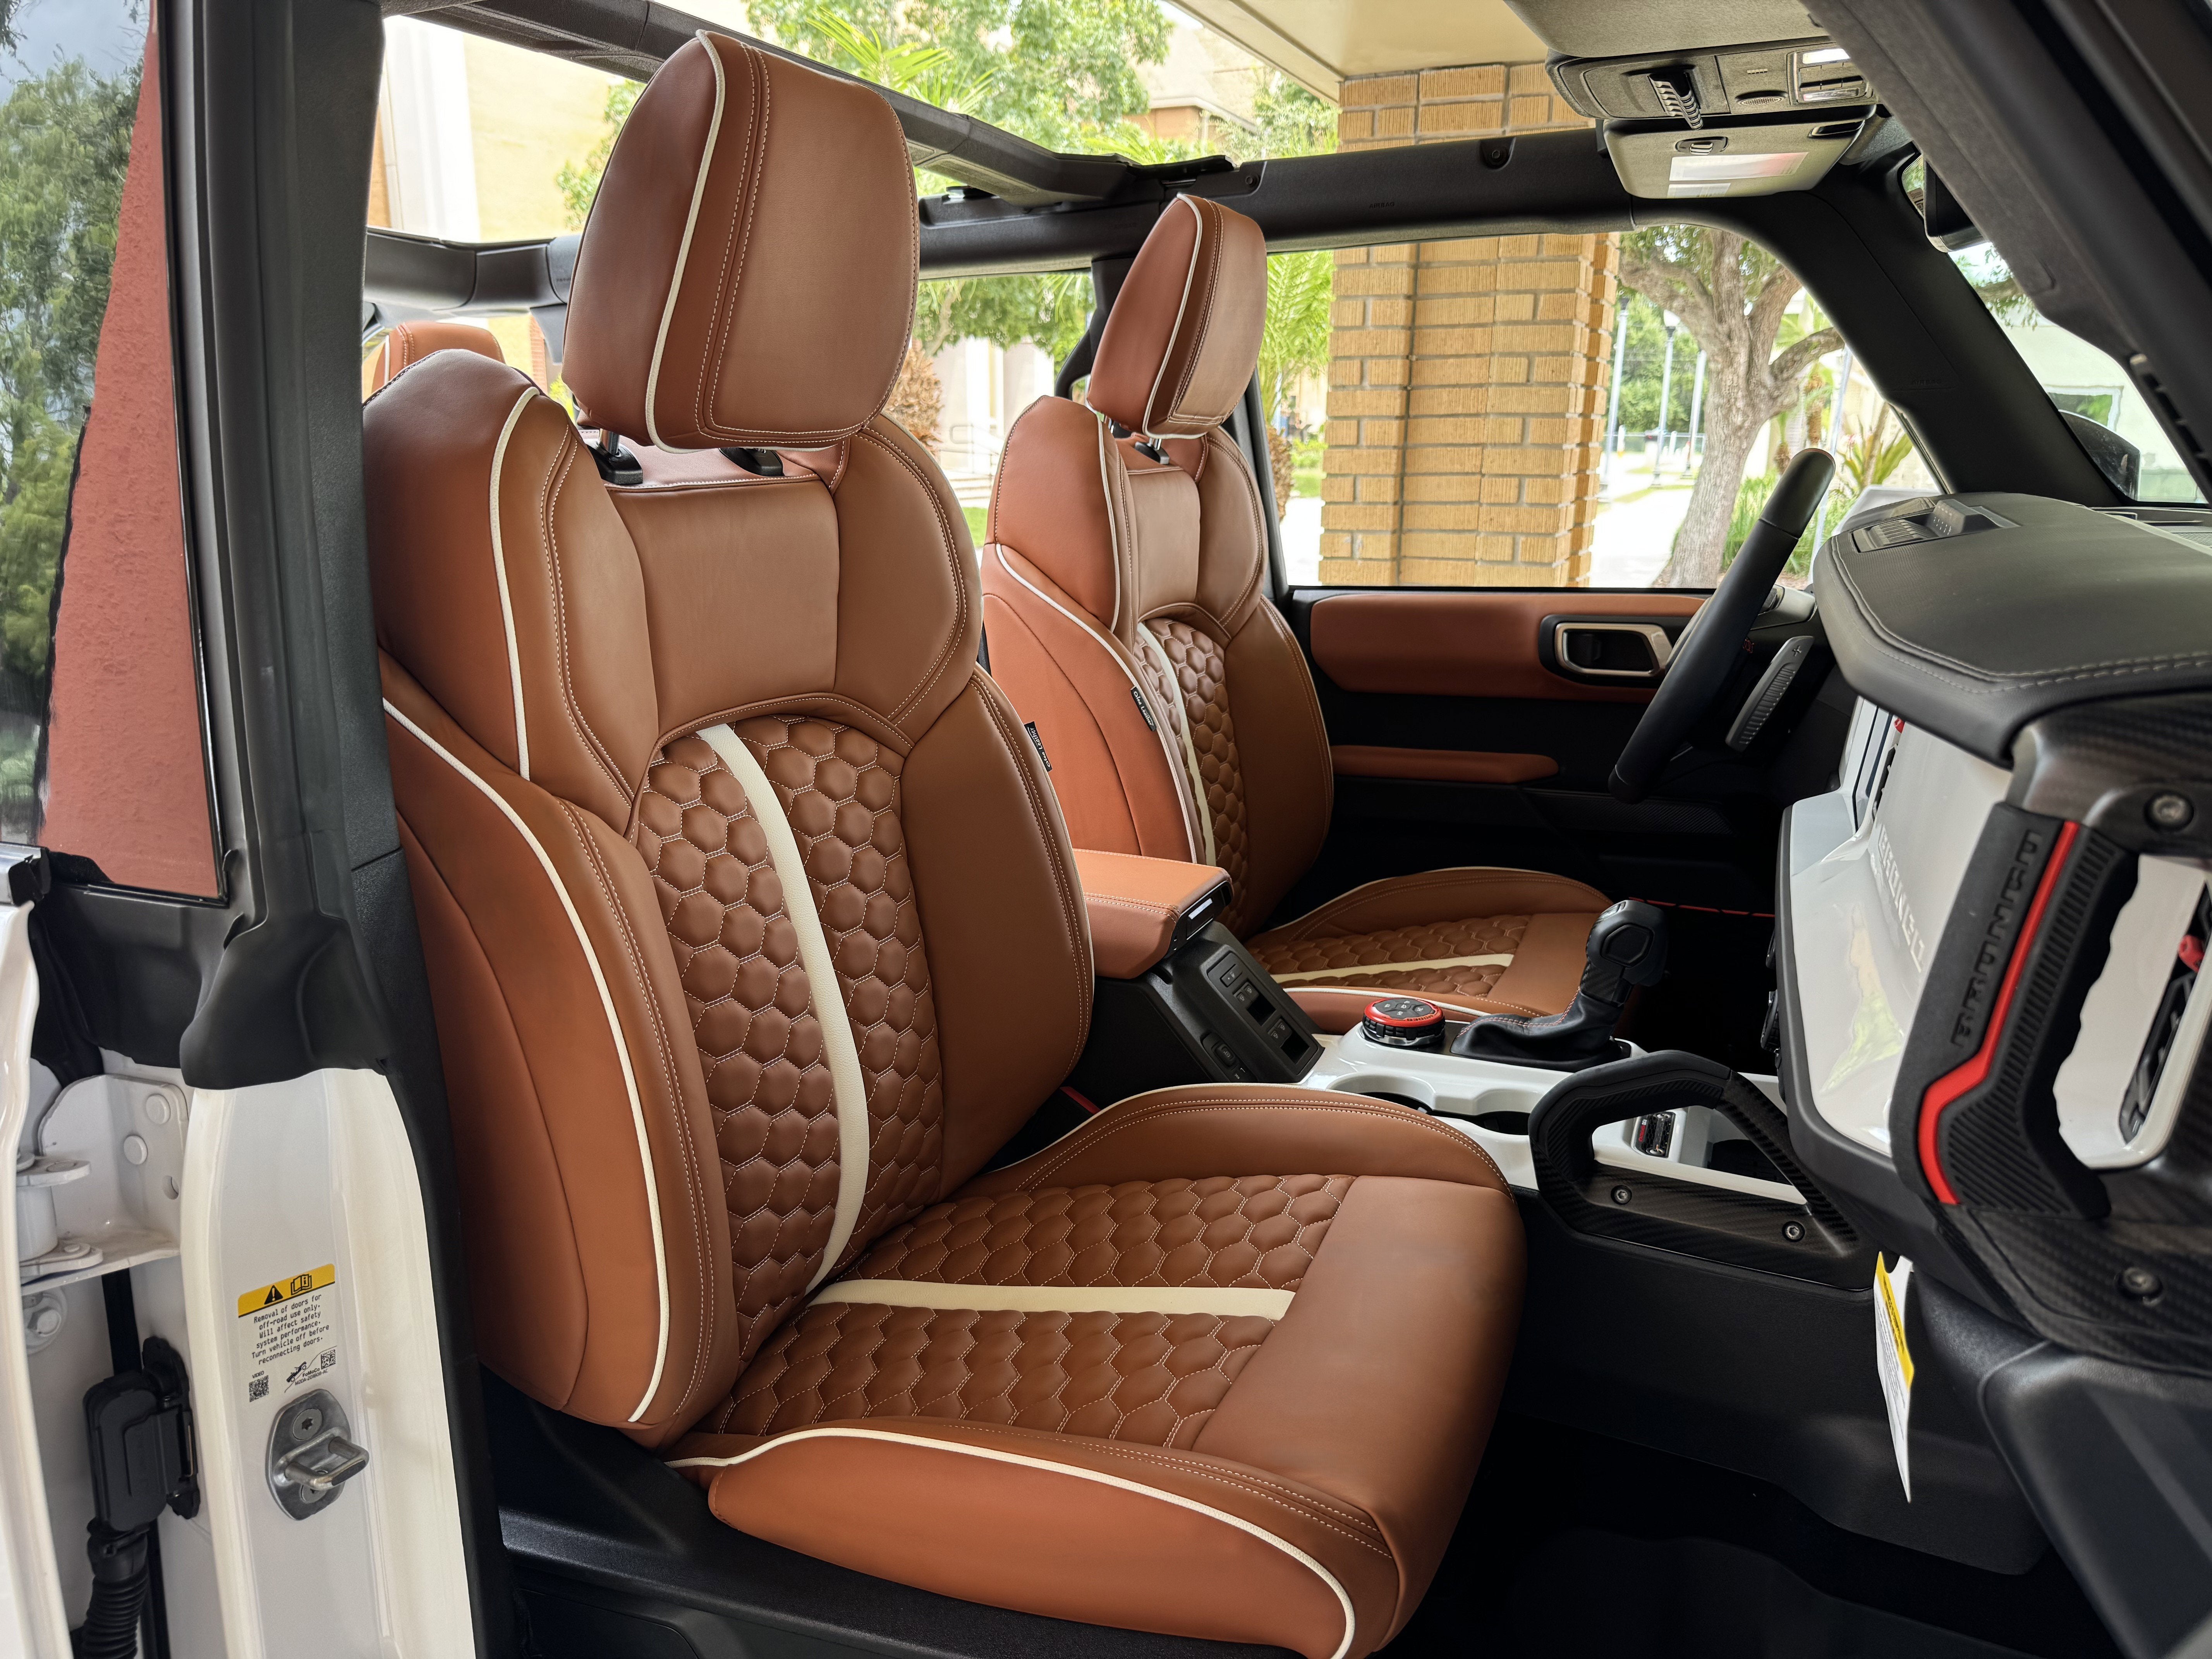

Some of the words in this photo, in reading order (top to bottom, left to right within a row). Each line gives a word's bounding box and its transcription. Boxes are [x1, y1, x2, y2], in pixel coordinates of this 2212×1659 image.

[1141, 706, 1152, 725] Leather
[1030, 728, 1043, 750] Leather
[254, 1309, 278, 1323] Removal
[291, 1299, 308, 1310] doors
[259, 1315, 287, 1330] off-road
[304, 1304, 320, 1313] only.
[256, 1337, 277, 1349] system
[281, 1321, 321, 1340] performance.
[259, 1328, 273, 1338] Will
[277, 1319, 297, 1332] affect
[301, 1312, 321, 1322] safety
[252, 1349, 266, 1358] Turn
[270, 1339, 293, 1352] vehicle
[296, 1333, 306, 1341] off
[309, 1324, 329, 1336] before
[259, 1345, 300, 1365] reconnecting
[303, 1337, 323, 1347] doors.
[252, 1370, 264, 1379] VIDEO
[302, 1368, 320, 1377] FoMoCo
